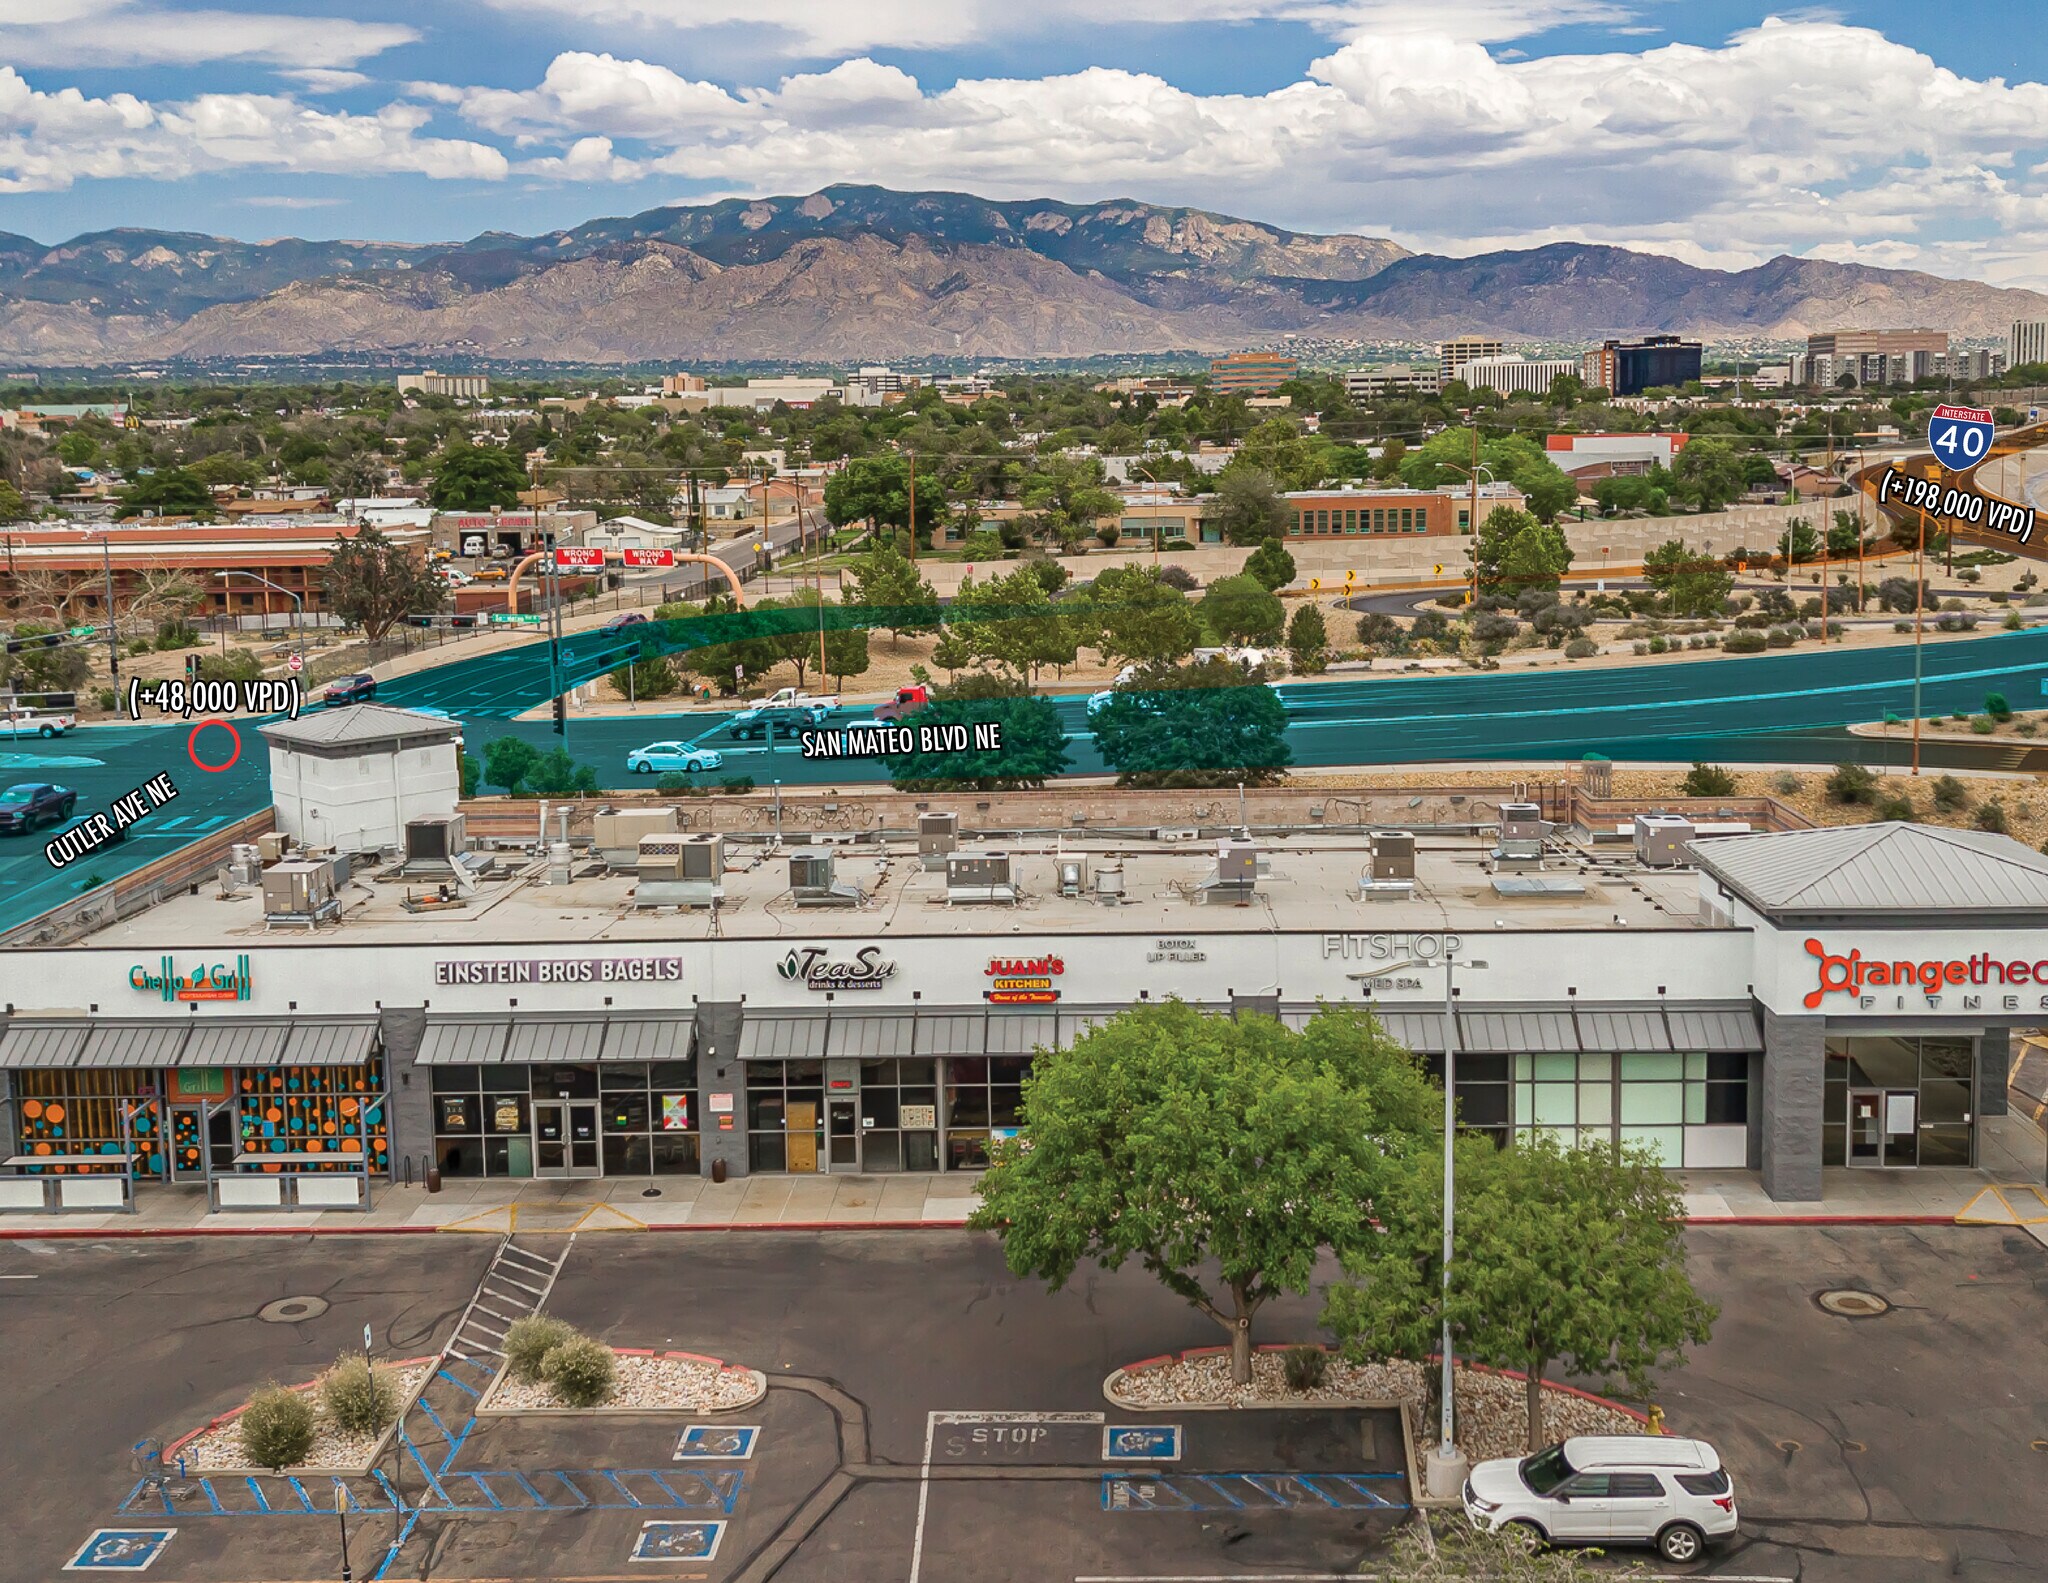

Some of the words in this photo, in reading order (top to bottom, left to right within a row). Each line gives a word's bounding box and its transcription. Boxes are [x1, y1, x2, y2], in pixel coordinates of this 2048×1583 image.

[458, 517, 487, 528] AUTO
[563, 549, 596, 558] WRONG
[632, 549, 665, 558] WRONG
[639, 557, 658, 565] WAY
[1156, 939, 1196, 950] BOTOX
[1322, 933, 1462, 959] FITSHOP
[800, 946, 896, 980] TeaSu
[1147, 952, 1165, 963] LIP
[1168, 952, 1207, 962] FILLER
[983, 954, 1064, 976] JUANI'S
[435, 962, 531, 984] EINSTEIN
[538, 960, 593, 982] BROS
[601, 958, 680, 981] BAGELS
[129, 955, 185, 1002] Chello
[210, 954, 251, 1001] Grill
[809, 980, 836, 989] drinks
[838, 980, 846, 989] &
[847, 980, 881, 989] desserts
[995, 979, 1050, 989] KITCHEN
[1361, 978, 1393, 990] MED
[1395, 978, 1424, 990] SPA
[971, 1427, 1048, 1443] STOP
